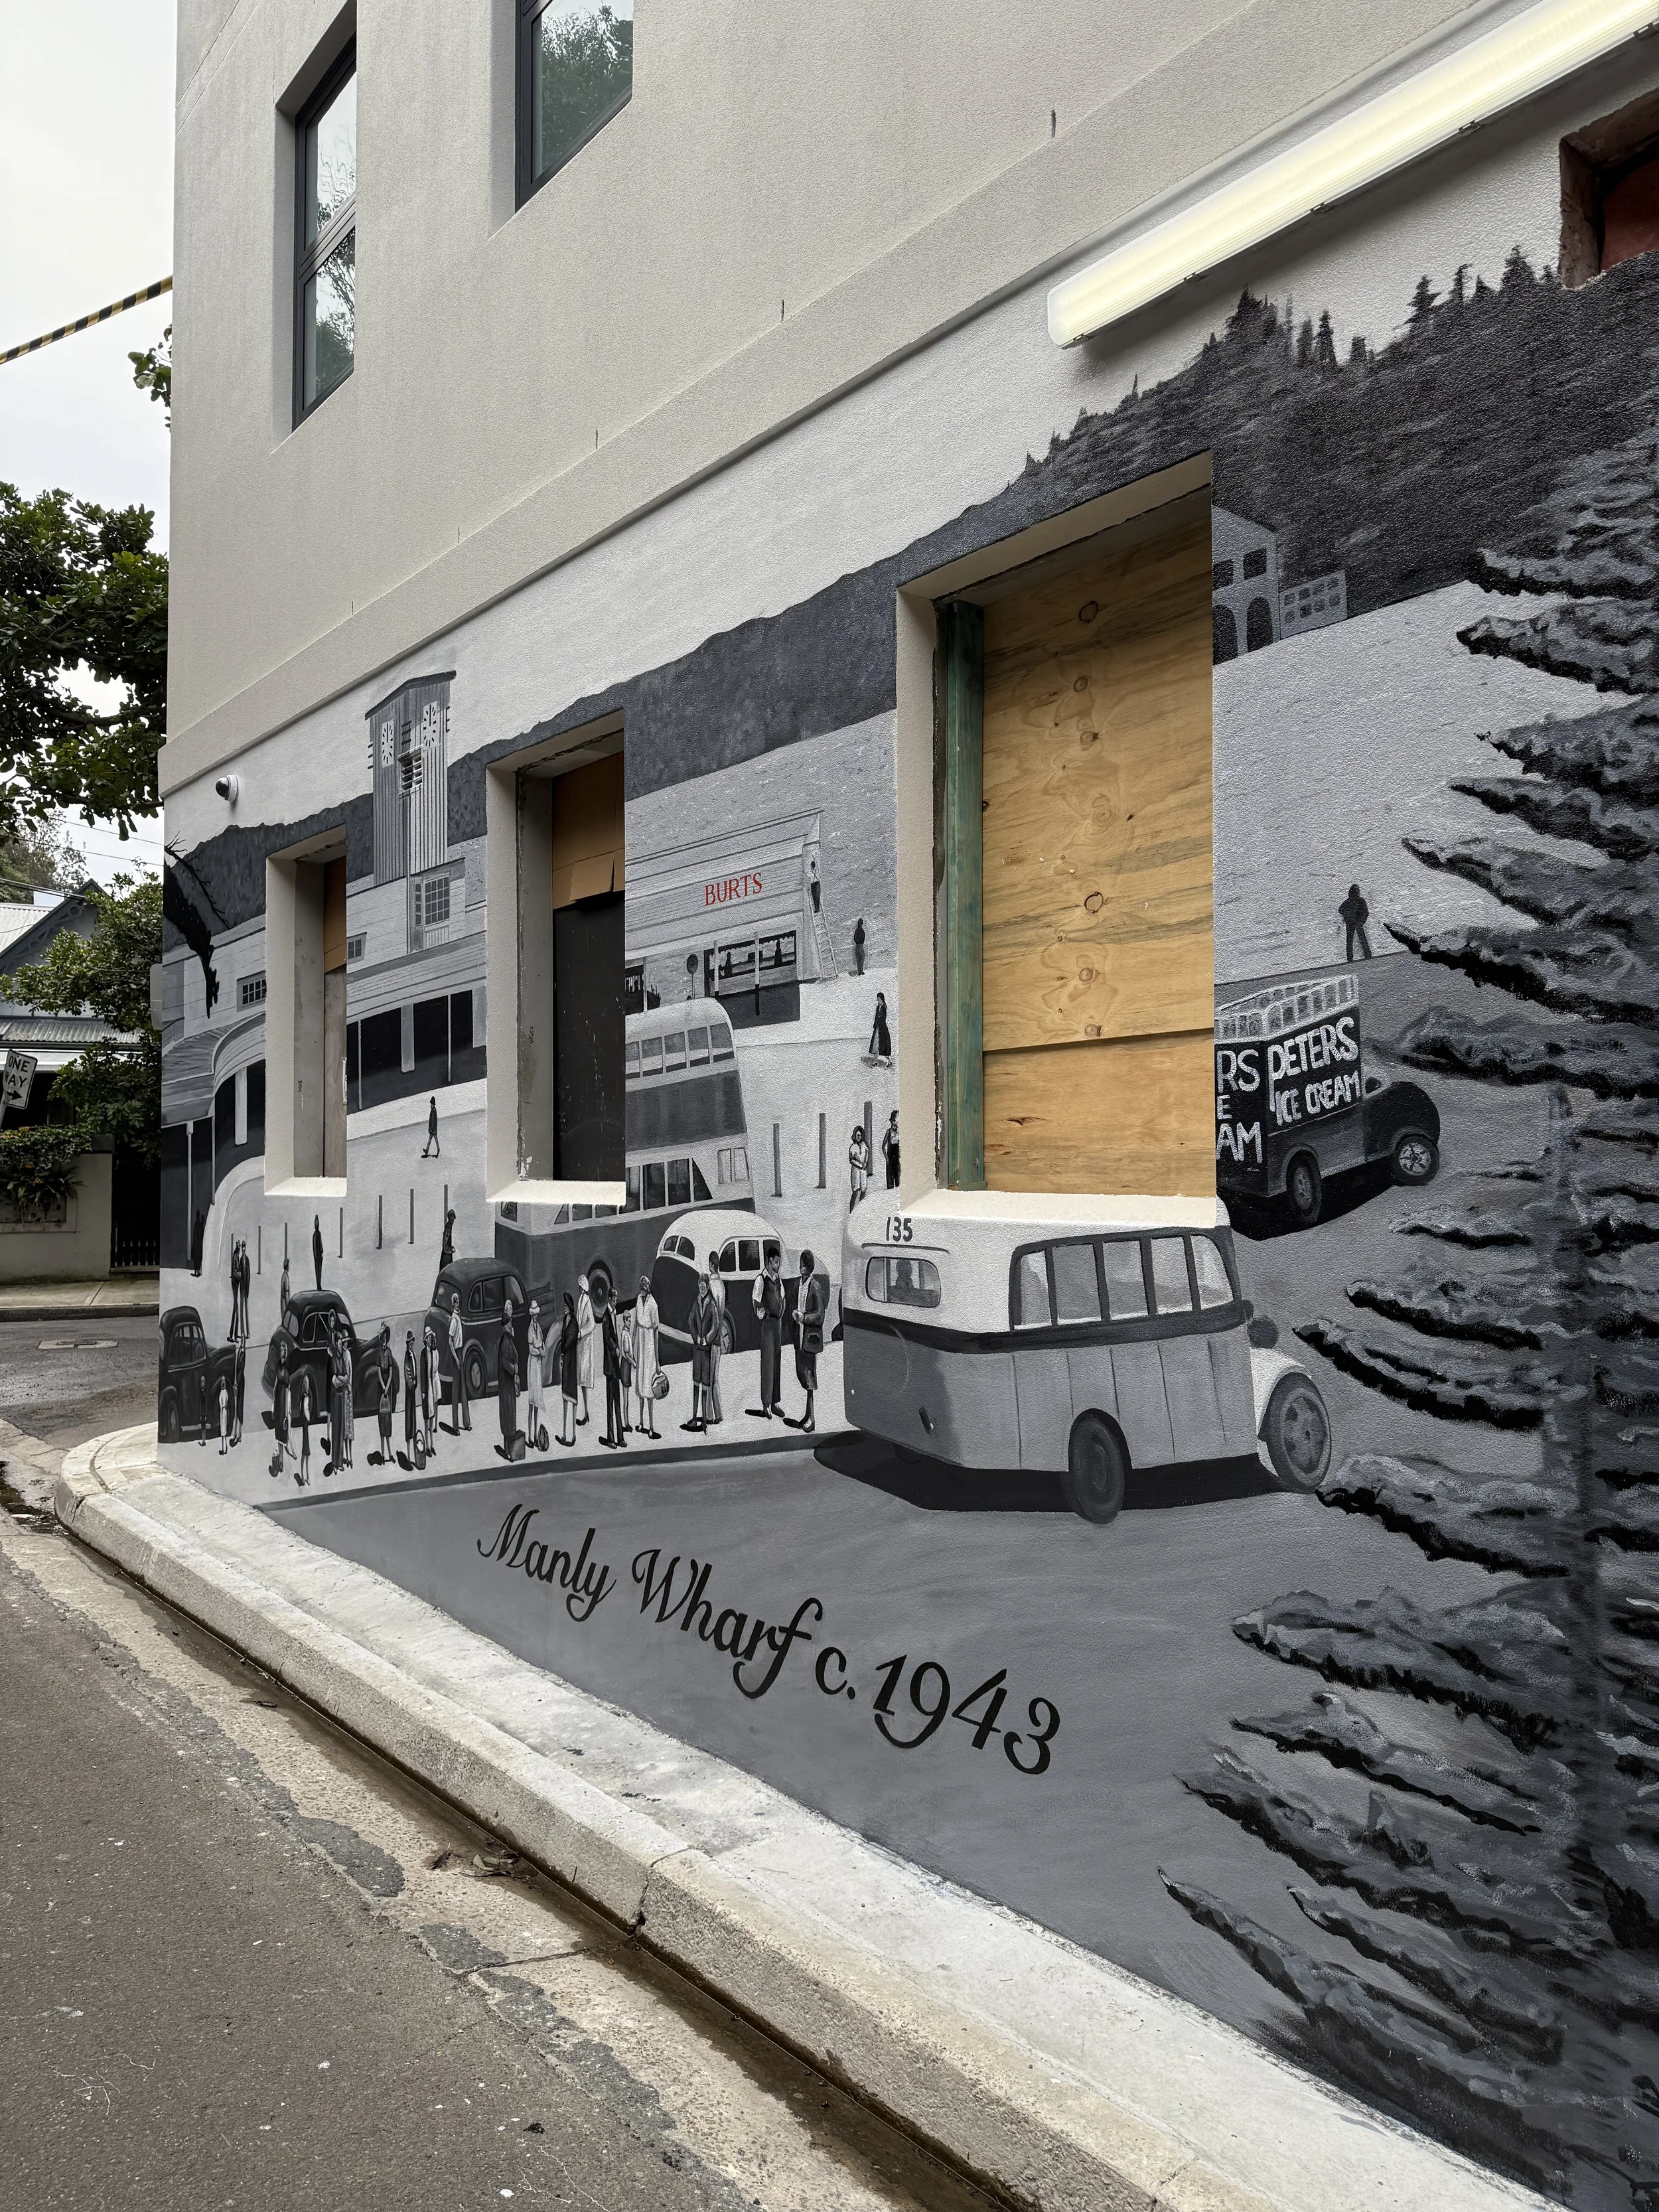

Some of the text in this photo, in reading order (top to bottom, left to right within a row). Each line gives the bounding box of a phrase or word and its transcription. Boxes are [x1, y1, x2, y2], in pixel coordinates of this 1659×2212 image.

[704, 873, 762, 906] BURTS
[4, 1070, 29, 1088] WAY
[8, 1055, 31, 1073] ONE
[1216, 1049, 1261, 1093] RS
[1267, 1016, 1359, 1112] PETERS
[1216, 1094, 1233, 1120] E
[1275, 1070, 1361, 1126] ICE CREAM
[1216, 1121, 1263, 1163] AM
[886, 1216, 913, 1242] 135
[476, 1503, 1061, 1776] Manly Wharf c. 1943
